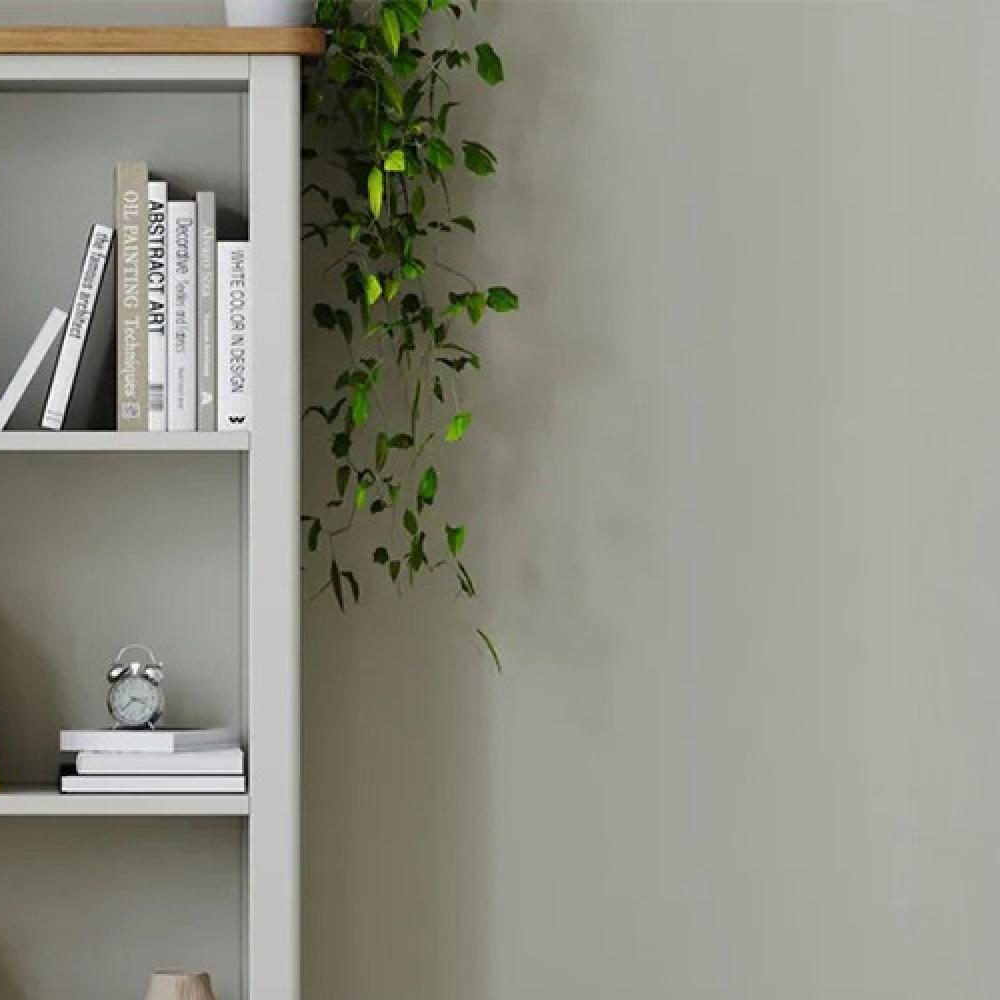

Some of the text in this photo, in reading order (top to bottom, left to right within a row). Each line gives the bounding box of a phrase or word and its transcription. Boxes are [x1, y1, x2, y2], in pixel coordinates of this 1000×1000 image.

[120, 190, 140, 396] OIL PAINTING Techniques
[148, 200, 164, 336] ABSTRACT ART
[175, 218, 192, 274] Decorative
[230, 250, 245, 393] WHITE COLOR IN DESIGN
